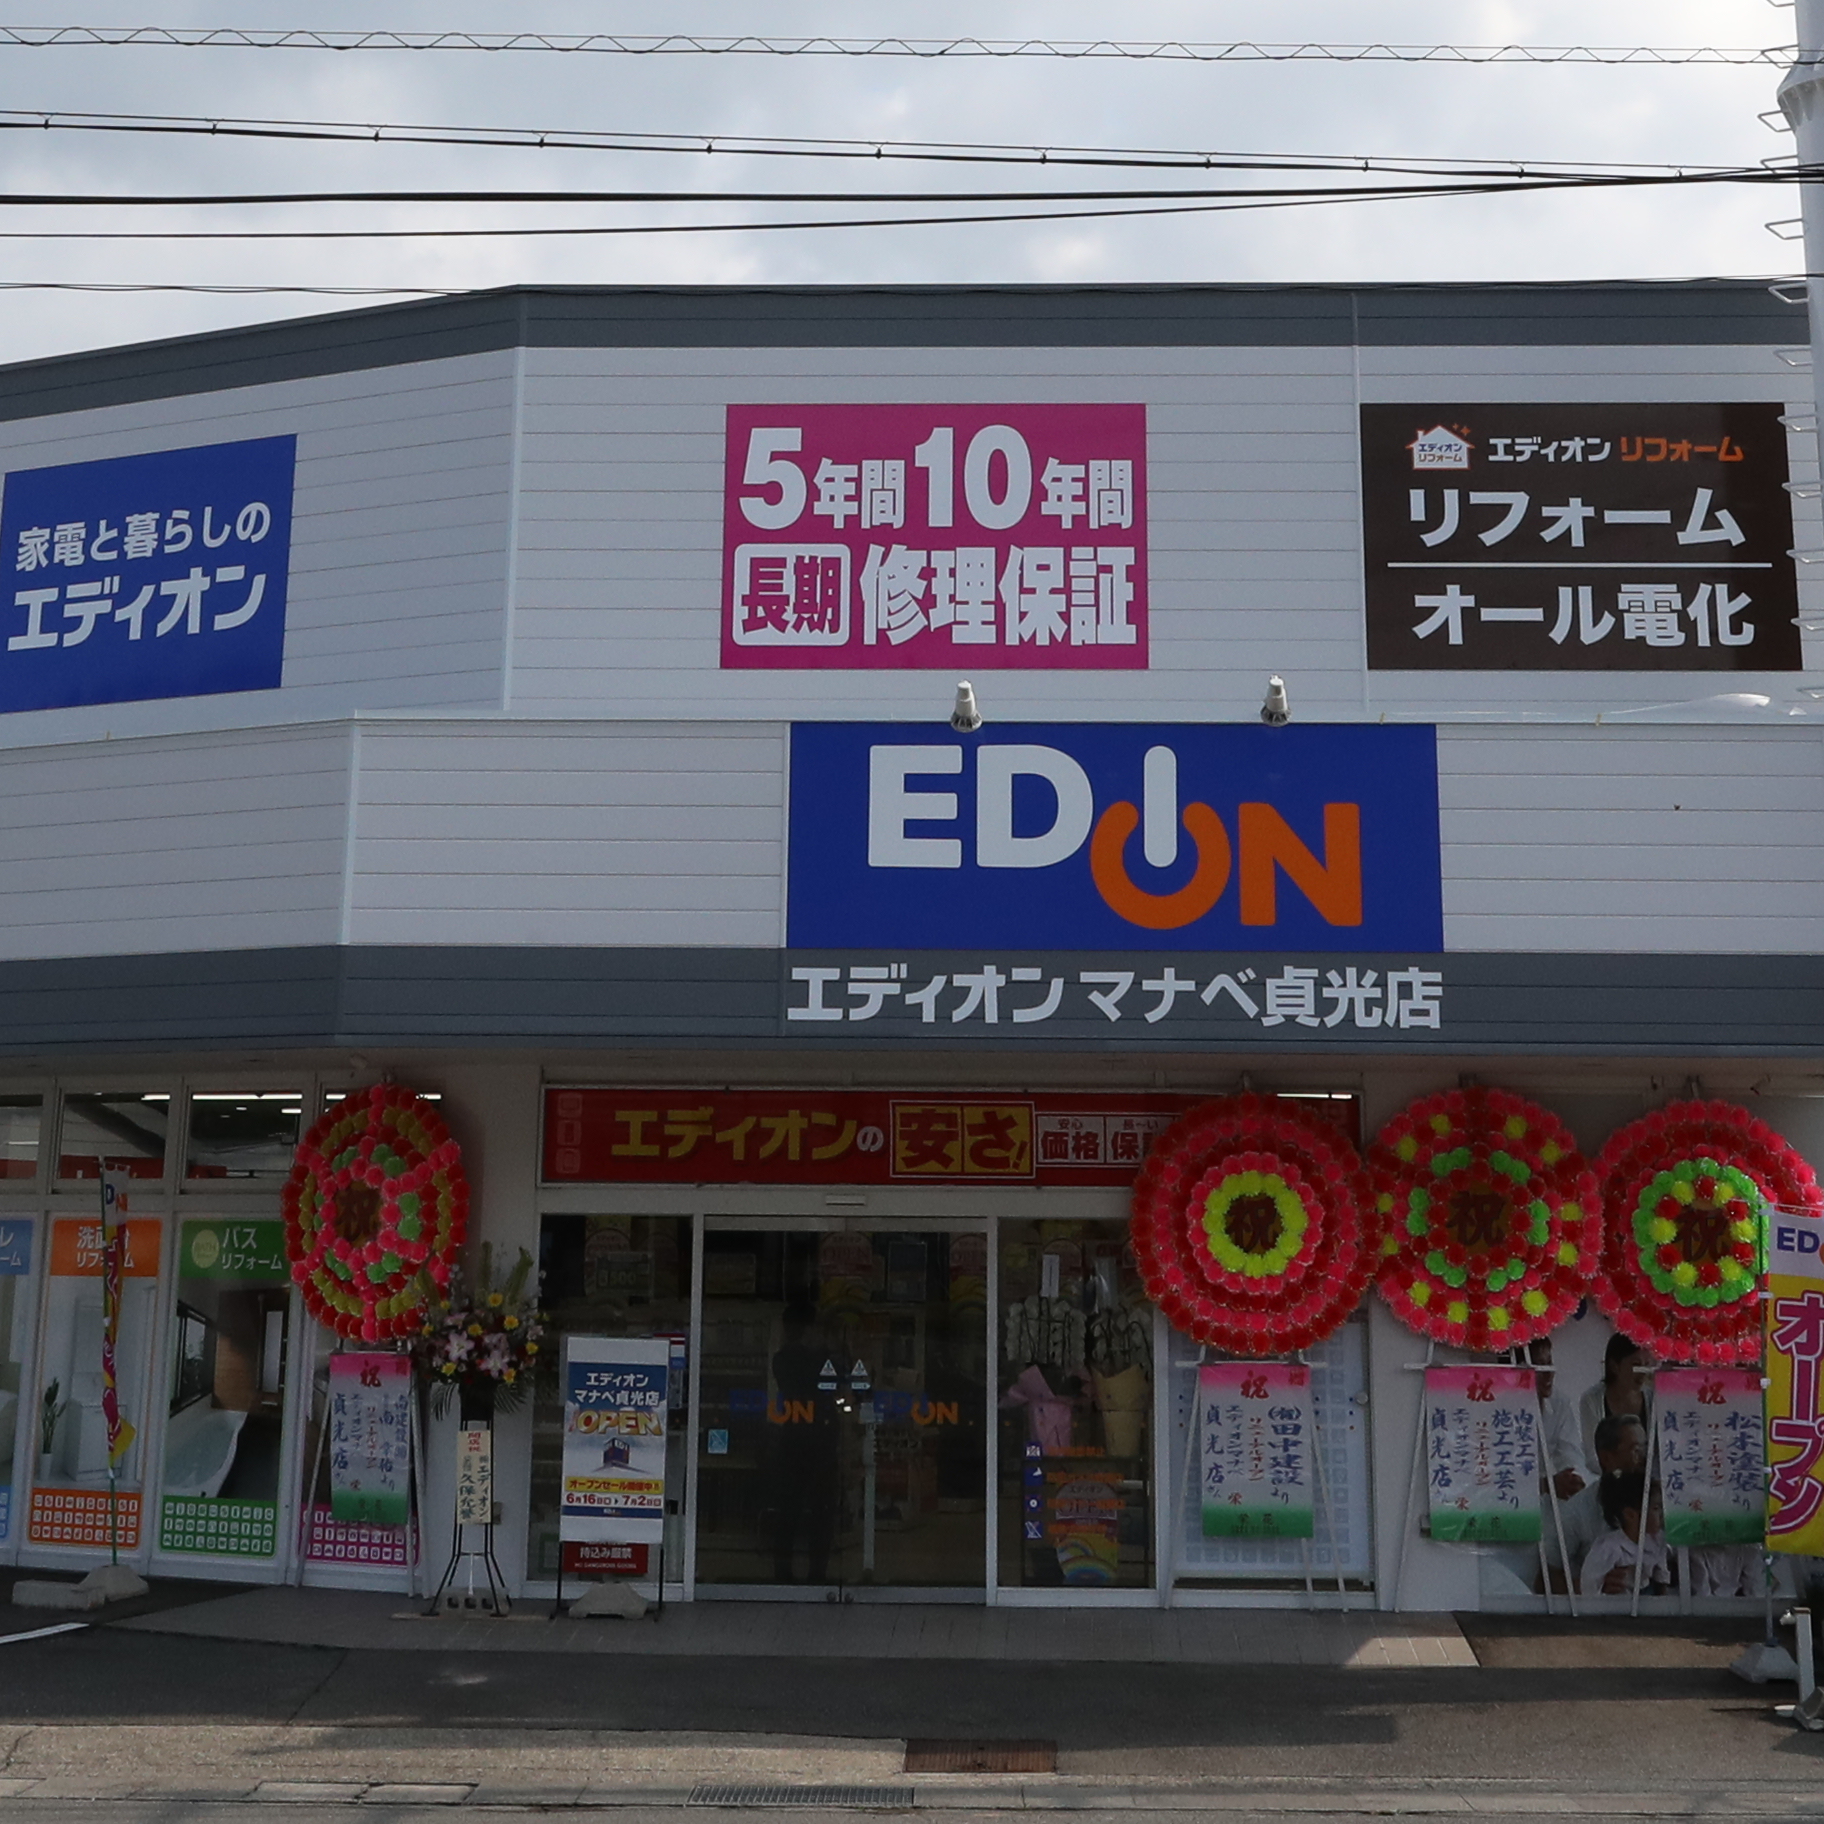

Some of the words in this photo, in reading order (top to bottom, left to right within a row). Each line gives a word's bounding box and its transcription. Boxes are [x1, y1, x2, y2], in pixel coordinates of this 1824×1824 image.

[1418, 442, 1462, 453] エディオン
[1418, 453, 1462, 463] リフォーム
[1488, 436, 1611, 463] エディオン
[1620, 436, 1744, 463] リフォーム
[1409, 487, 1746, 547] リフォーム
[16, 501, 271, 572] 家電と暮らしの
[7, 564, 266, 651] エディオン
[860, 544, 1137, 645] 修理保証
[1412, 583, 1755, 647] オール電化
[868, 745, 1363, 930] EDION
[787, 964, 1064, 1024] エディオン
[1080, 966, 1442, 1030] マナベ貞光店
[1041, 1131, 1100, 1161] 価格
[223, 1228, 257, 1249] バス
[77, 1253, 135, 1269] リフム
[221, 1253, 283, 1270] リフォーム
[360, 1359, 382, 1388] 祝
[585, 1372, 649, 1388] エディオン
[1240, 1369, 1270, 1400] 祝
[1466, 1372, 1495, 1403] 祝
[574, 1389, 660, 1407] マナベ貞光店
[1697, 1375, 1727, 1405] 祝
[576, 1409, 664, 1437] OPEN
